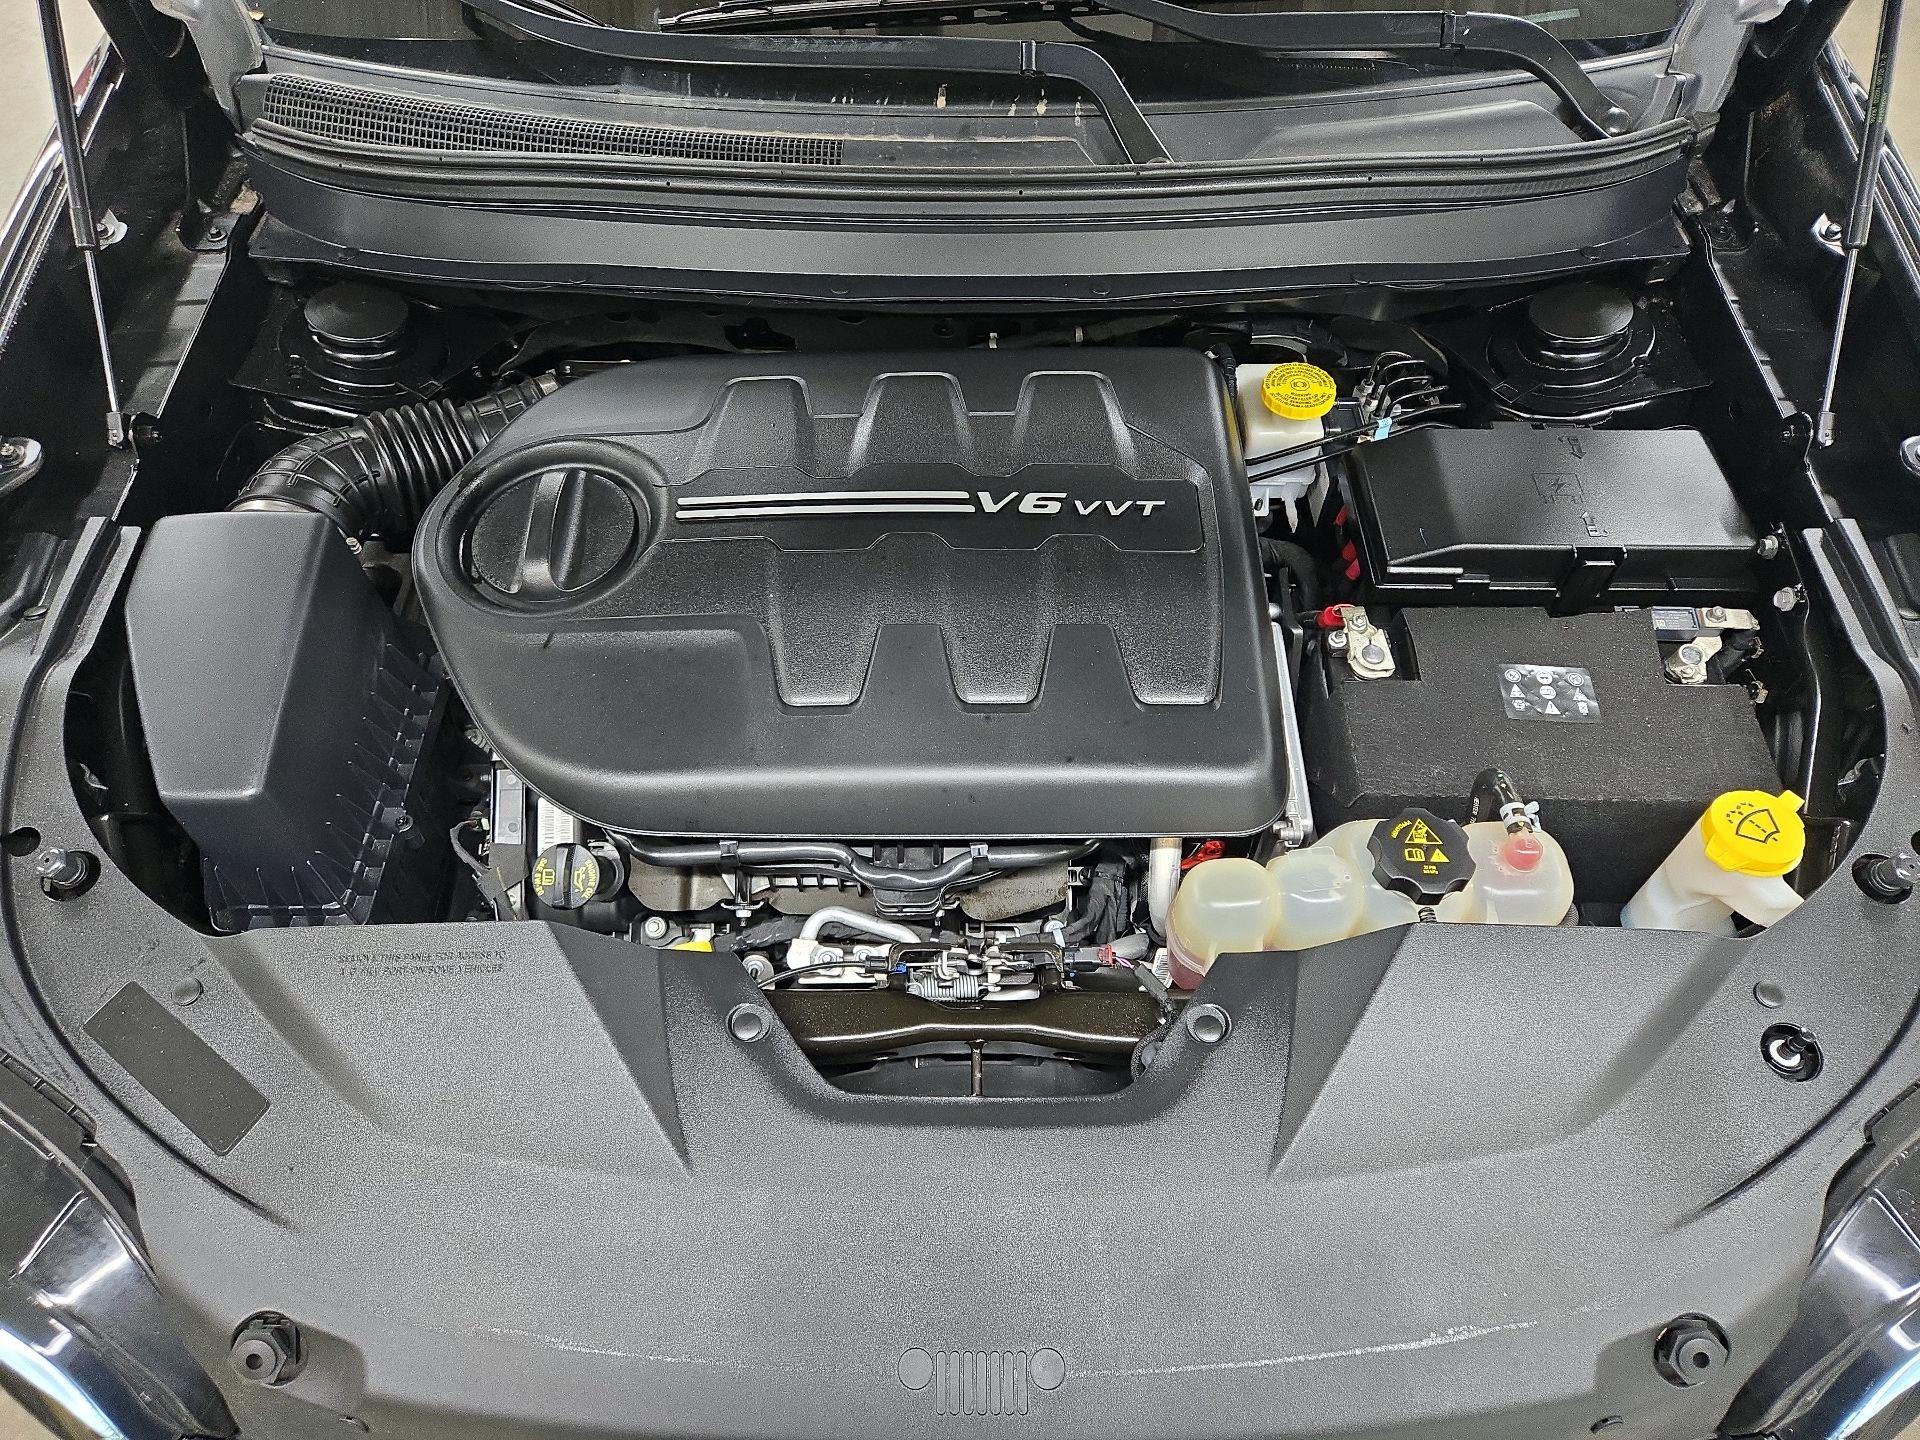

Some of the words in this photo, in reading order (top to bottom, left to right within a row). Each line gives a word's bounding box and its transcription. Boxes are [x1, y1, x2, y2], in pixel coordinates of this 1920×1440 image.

[976, 491, 1067, 515] V6
[1074, 500, 1166, 517] VVT
[536, 858, 547, 873] SAE
[585, 859, 596, 887] ENGINE
[581, 887, 594, 900] OIL
